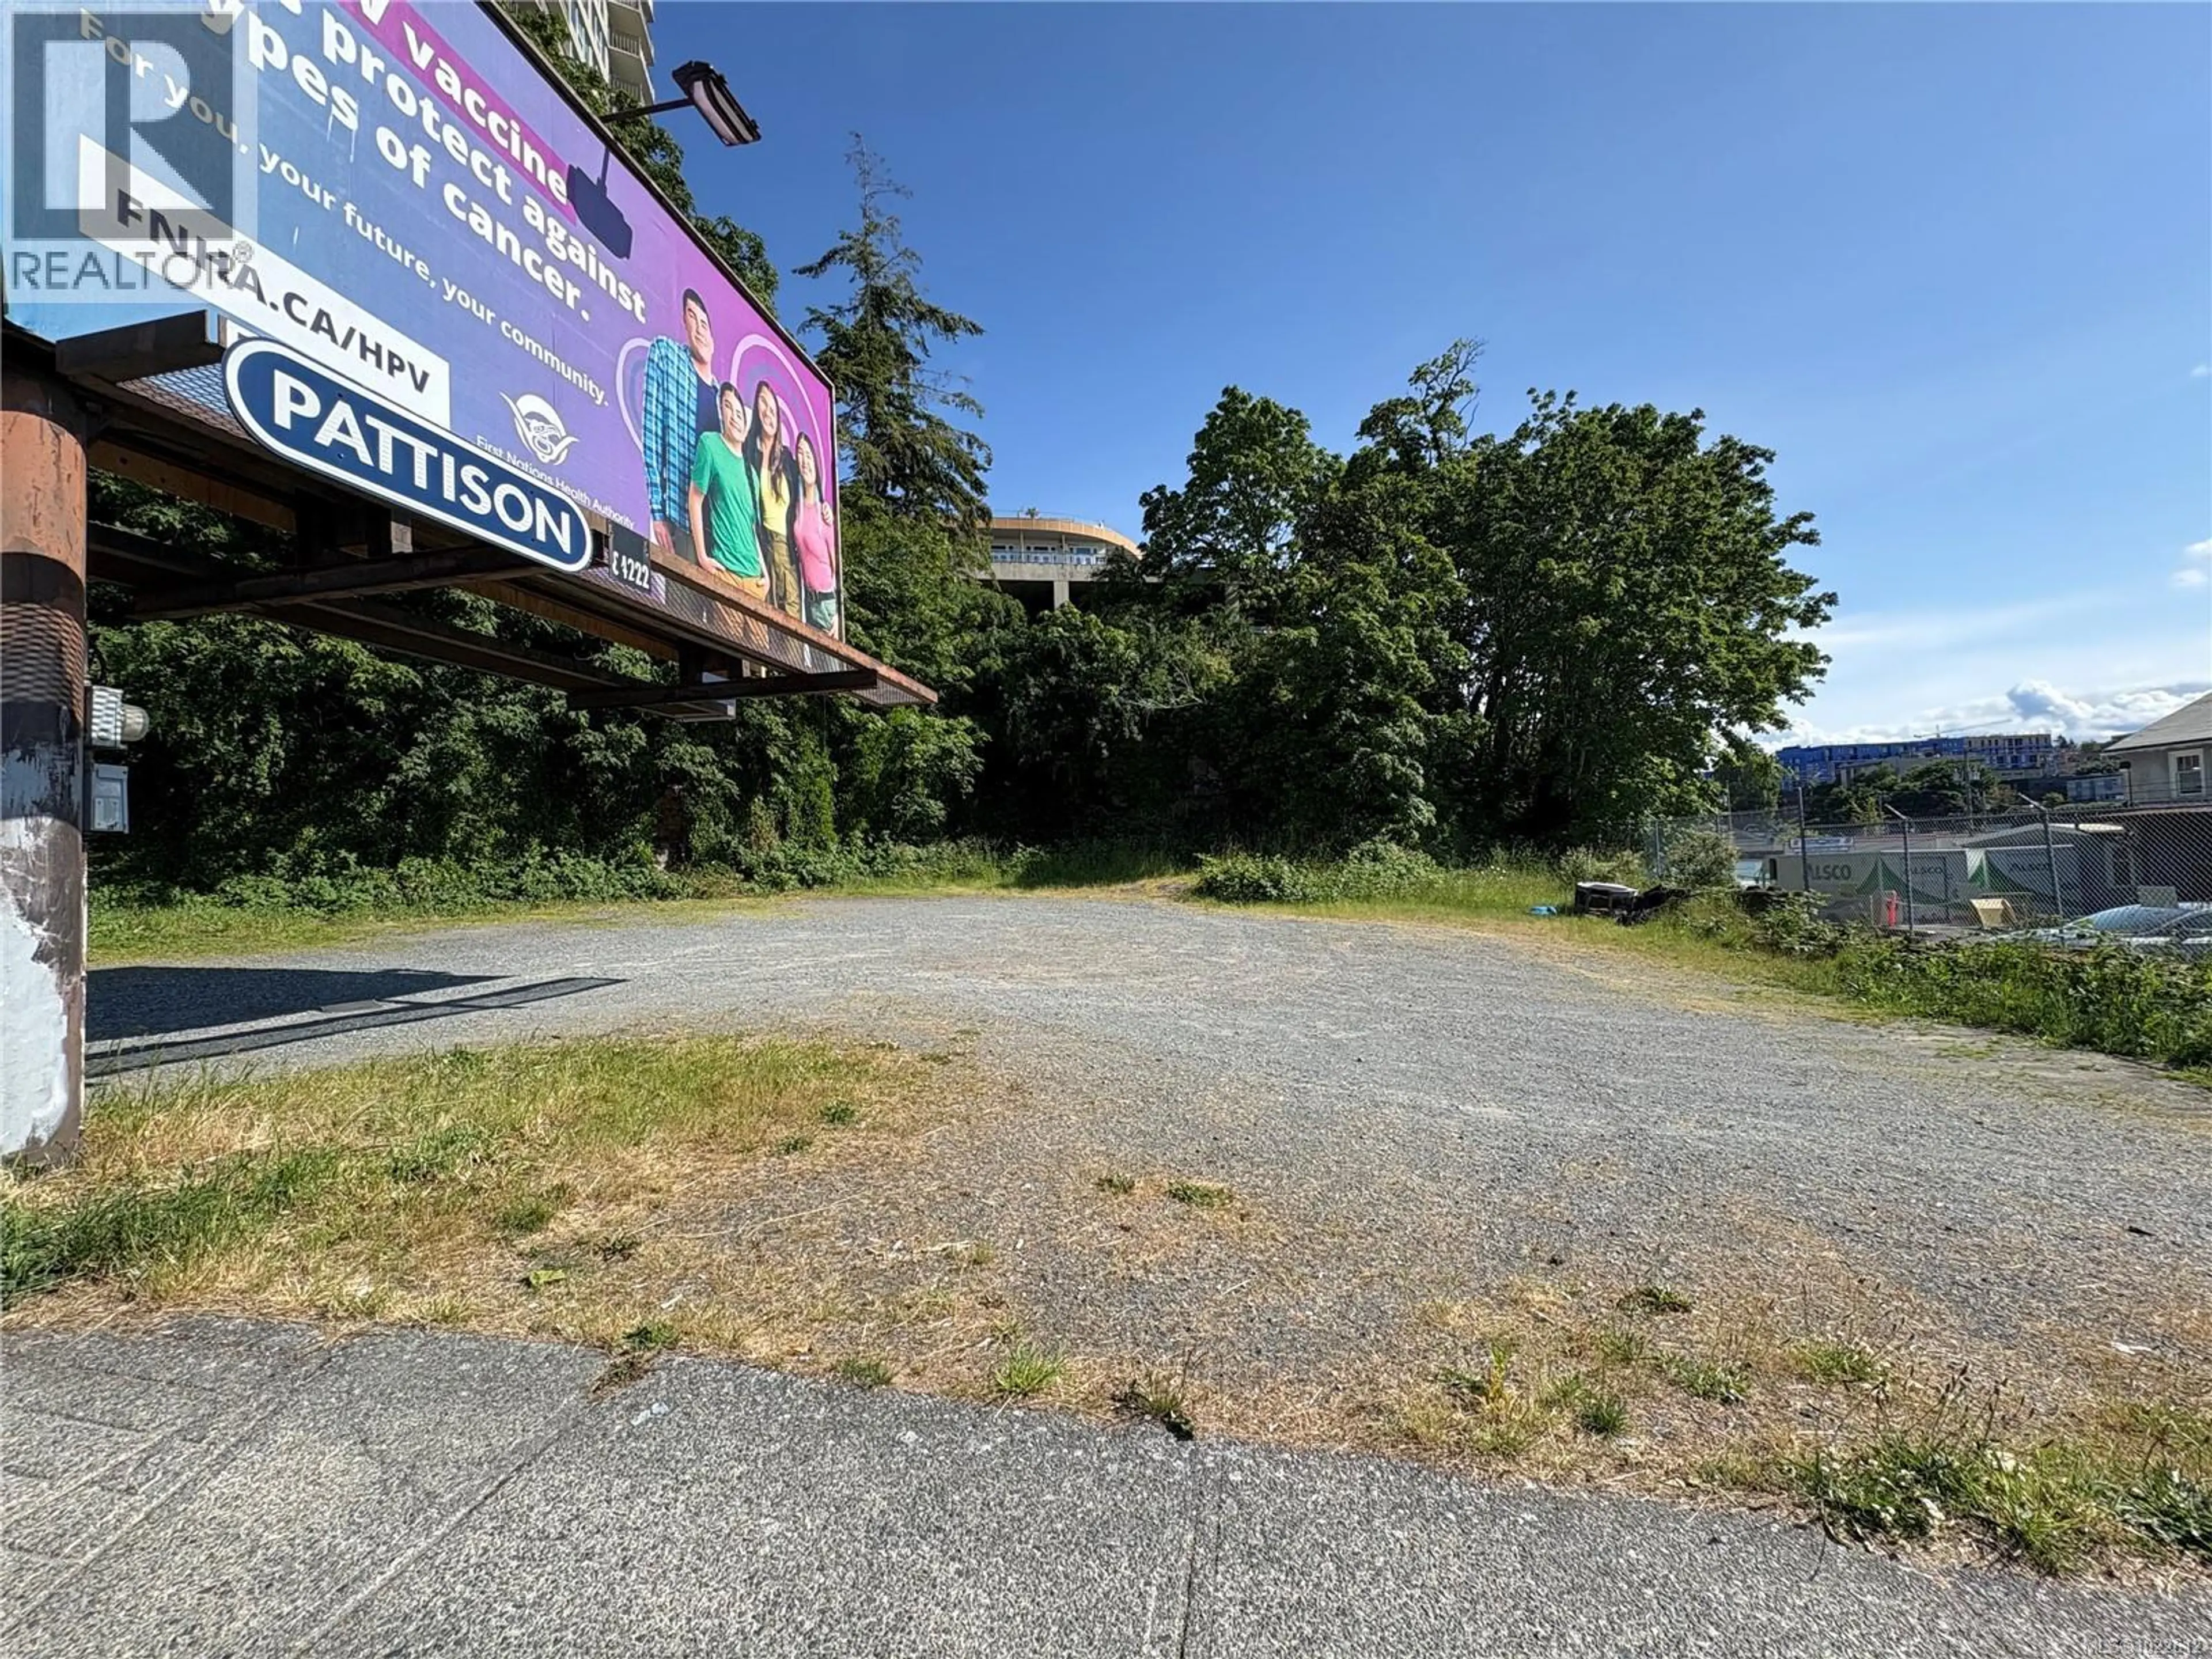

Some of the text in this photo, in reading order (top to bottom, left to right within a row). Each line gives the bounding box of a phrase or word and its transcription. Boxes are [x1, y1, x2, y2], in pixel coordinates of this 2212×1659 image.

[80, 7, 154, 78] For
[259, 143, 337, 211] your
[344, 201, 437, 289] future,
[441, 276, 497, 325] your
[501, 320, 609, 407] community.
[322, 8, 646, 324] protect against
[403, 21, 568, 206] vaccine
[376, 126, 431, 189] of
[444, 181, 590, 322] cancer.
[273, 368, 572, 554] PATTISON
[476, 435, 635, 530] First Nations Health Authority
